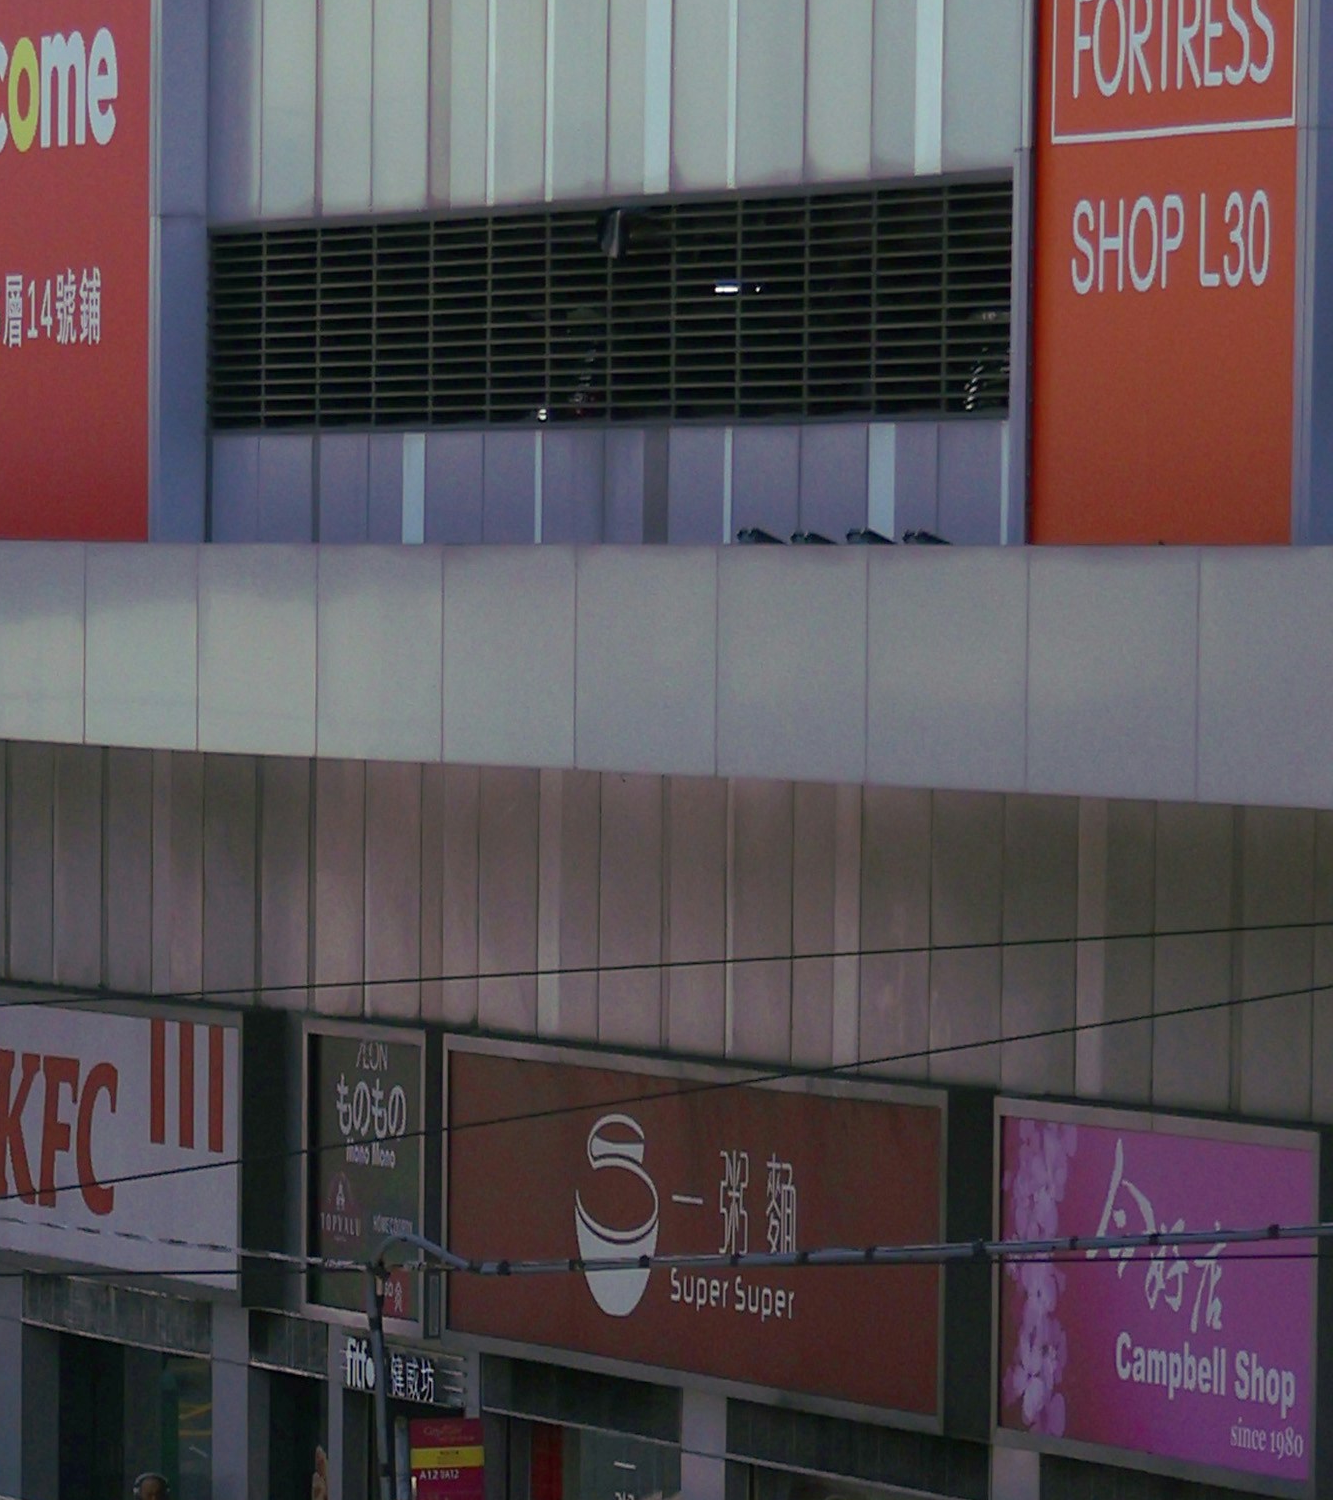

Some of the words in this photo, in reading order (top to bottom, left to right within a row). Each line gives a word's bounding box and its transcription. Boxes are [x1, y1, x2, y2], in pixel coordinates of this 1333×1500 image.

[1070, 195, 1185, 296] SHOP
[1197, 187, 1270, 289] L30
[335, 1072, 407, 1141] ものもの
[670, 1268, 729, 1311] Super
[734, 1275, 795, 1322] Super
[1115, 1332, 1227, 1399] Campbell
[1234, 1349, 1296, 1419] Shop
[1229, 1416, 1267, 1451] since
[1269, 1428, 1304, 1459] 1980
